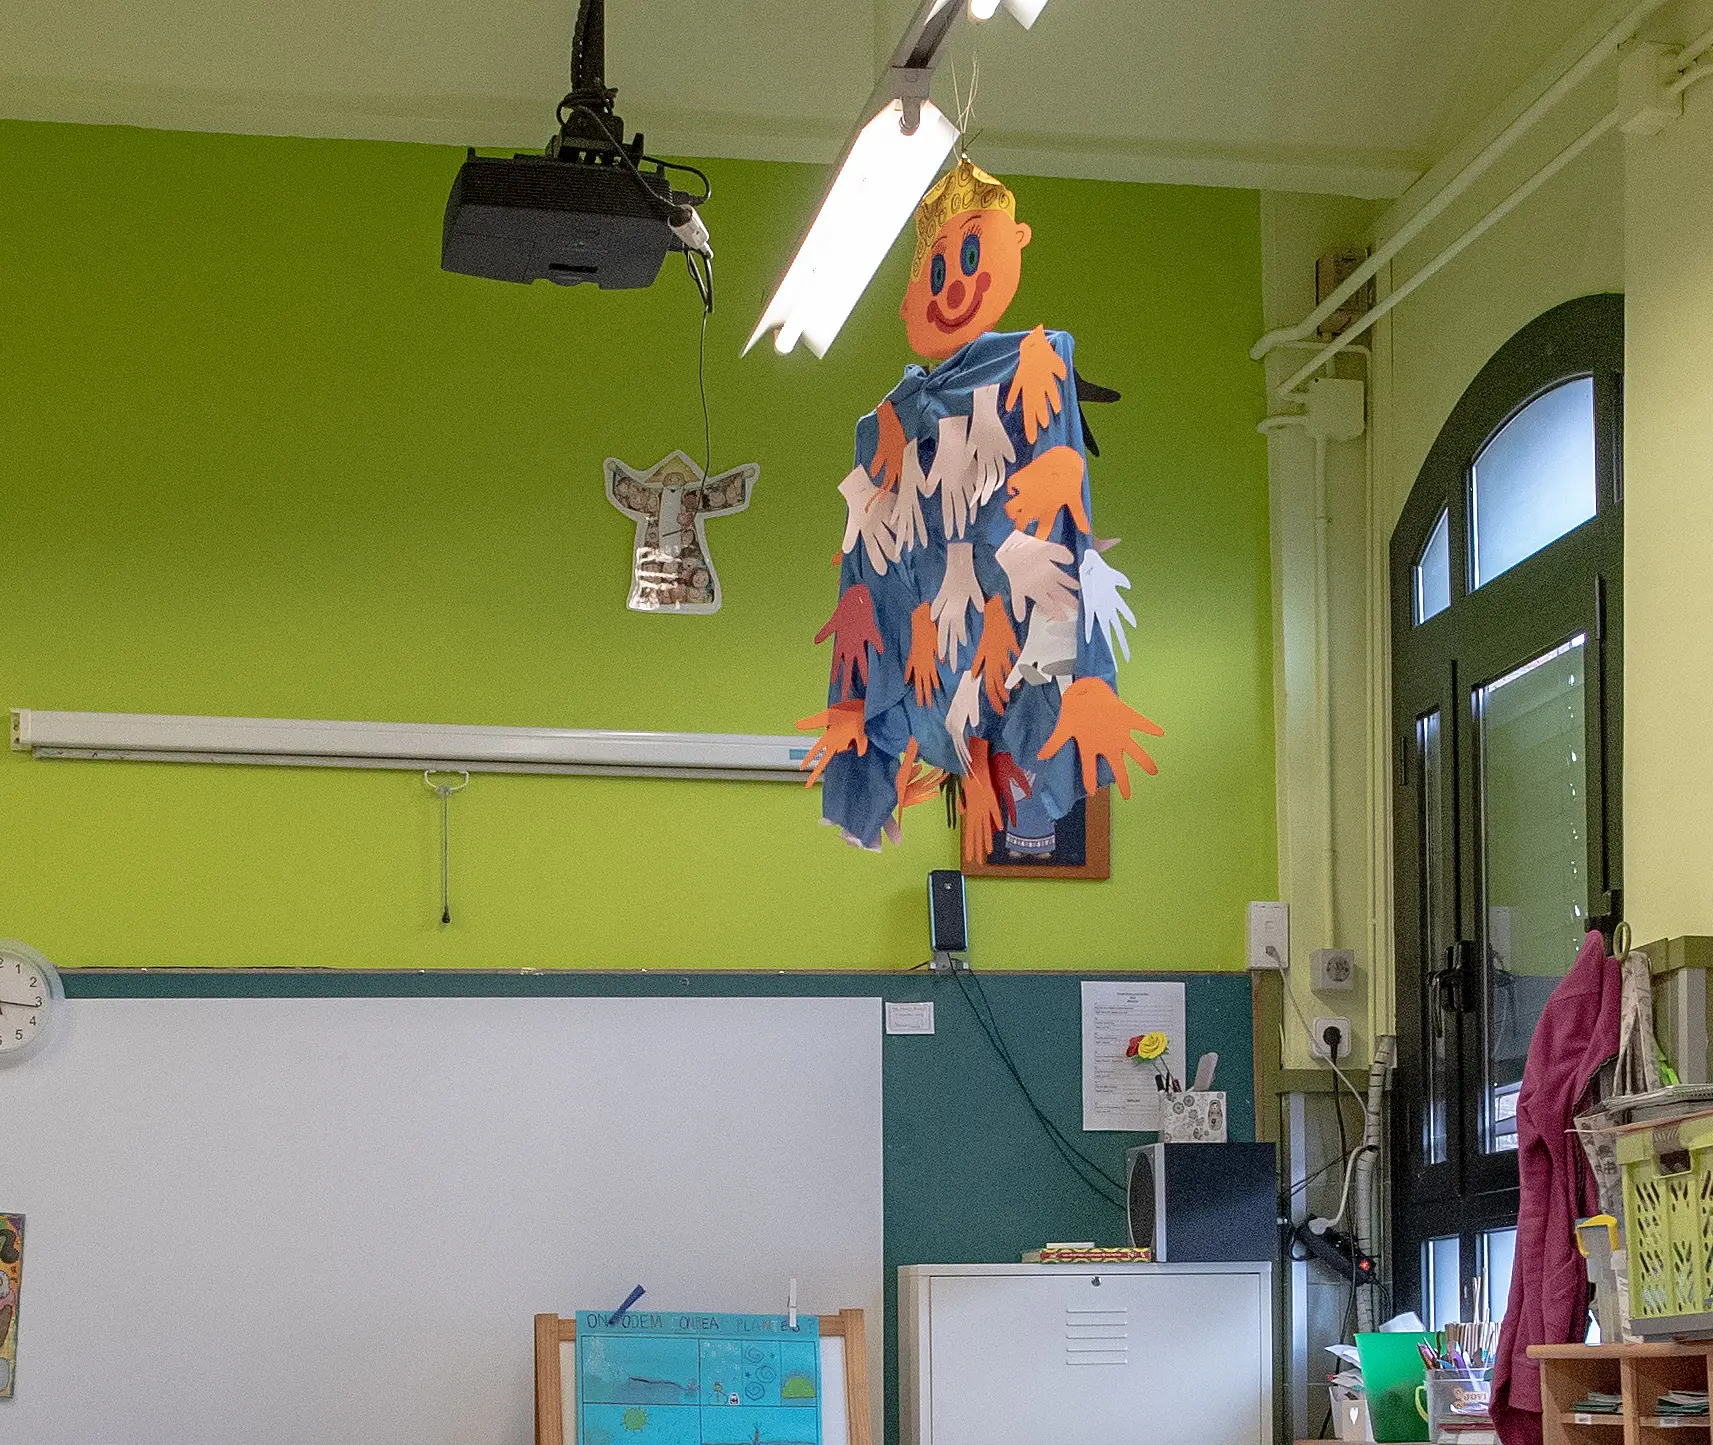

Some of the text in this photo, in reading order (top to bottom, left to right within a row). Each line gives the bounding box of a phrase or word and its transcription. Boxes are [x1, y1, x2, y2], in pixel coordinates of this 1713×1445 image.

[16, 964, 20, 974] 1
[30, 977, 37, 988] 2
[35, 996, 42, 1007] 3
[29, 1016, 36, 1026] 4
[16, 1030, 23, 1040] 5
[587, 1313, 609, 1329] ON
[612, 1315, 663, 1329] ODEM
